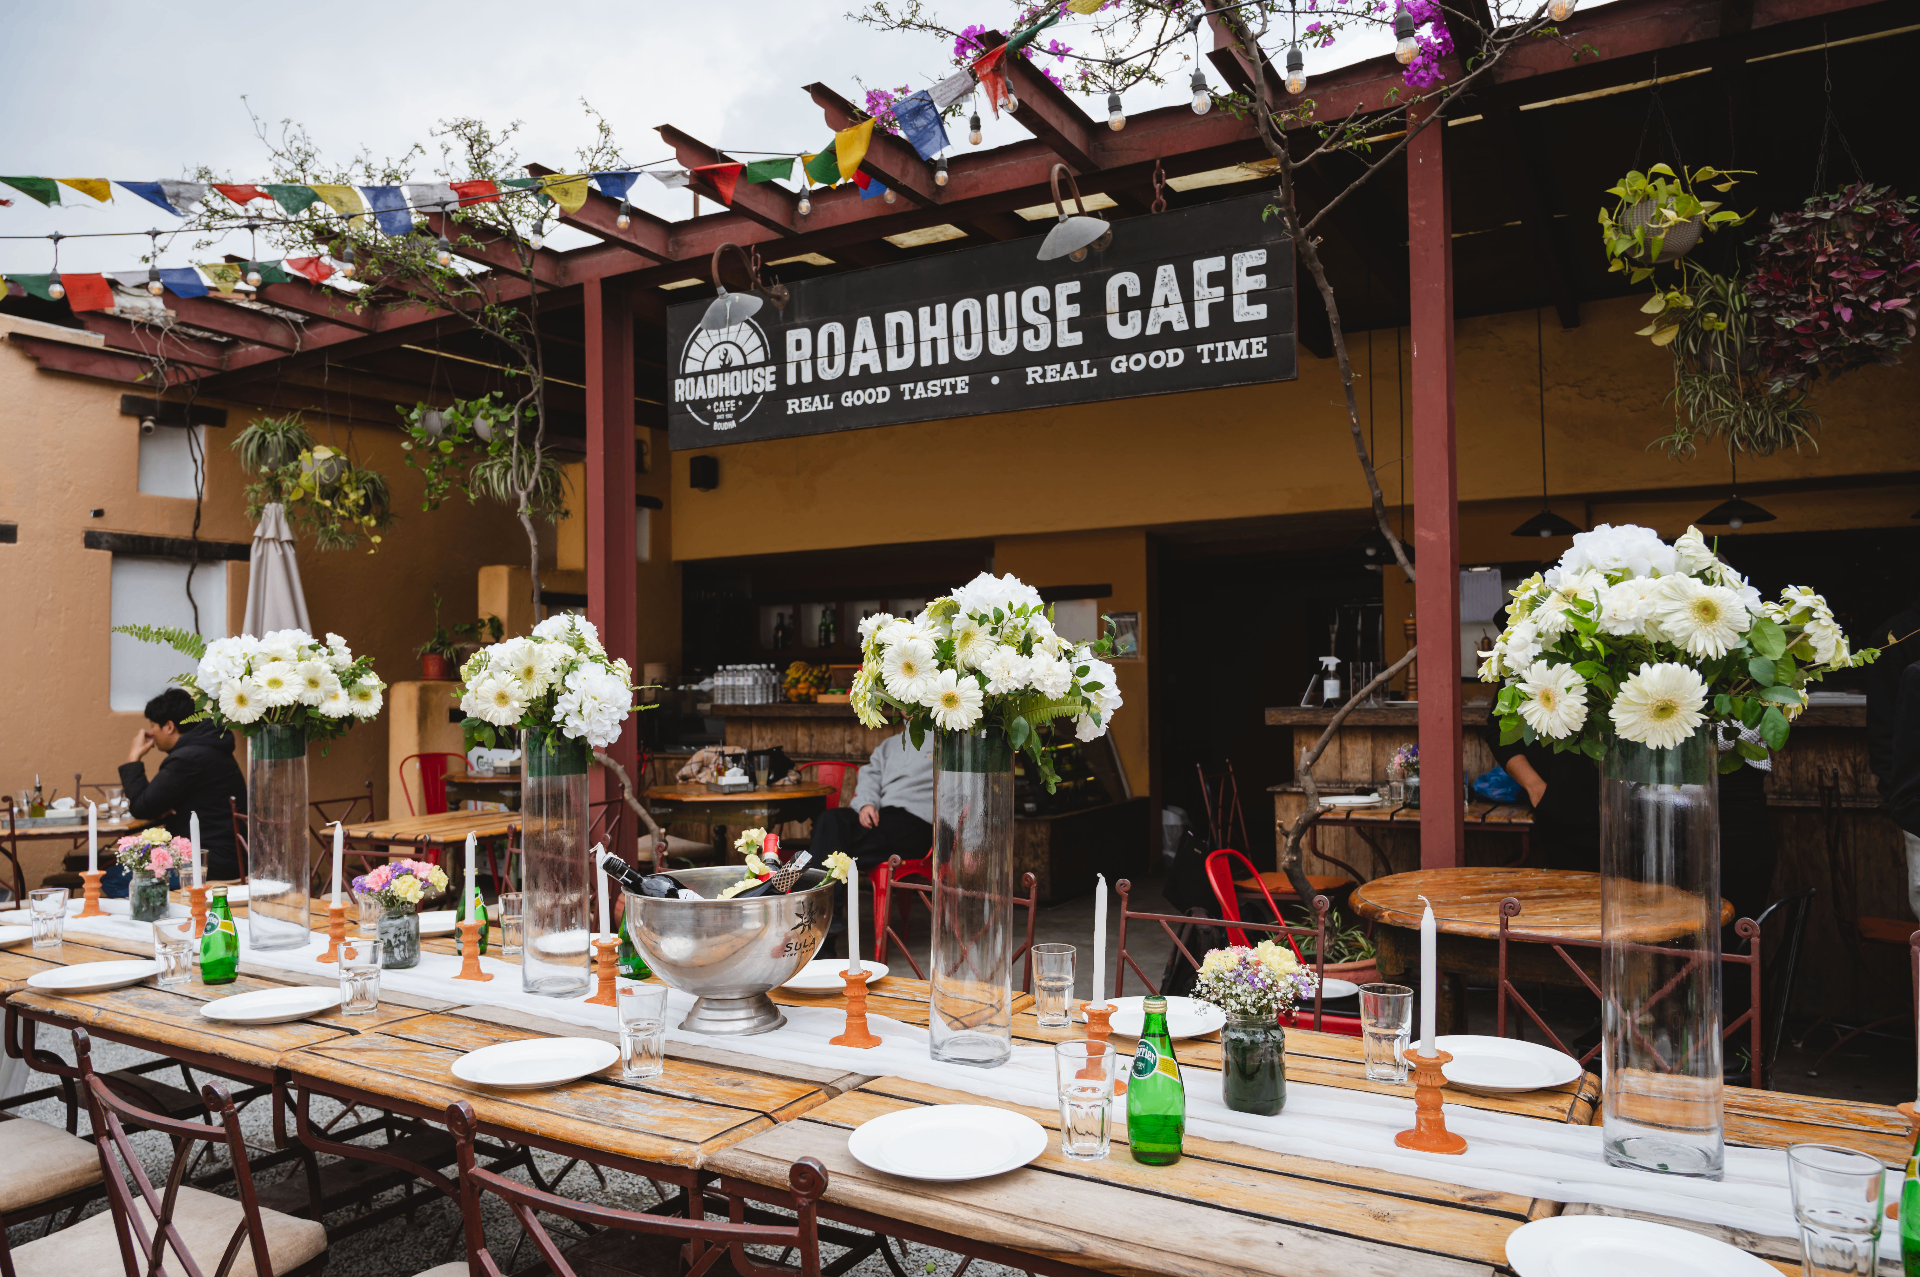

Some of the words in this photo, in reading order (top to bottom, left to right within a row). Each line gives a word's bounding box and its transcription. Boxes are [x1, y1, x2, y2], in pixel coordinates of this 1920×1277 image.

[786, 280, 1083, 386] ROADHOUSE
[1106, 249, 1268, 340] CAFE
[674, 365, 777, 403] ROADHOUSE
[786, 394, 834, 415] REAL
[841, 386, 891, 407] GOOD
[900, 376, 970, 401] TASTE
[1026, 360, 1098, 385] REAL
[1110, 348, 1185, 374] GOOD
[1197, 336, 1268, 364] TIME
[713, 399, 736, 413] CAFE
[784, 938, 816, 953] SULA
[1135, 1046, 1156, 1065] errier
